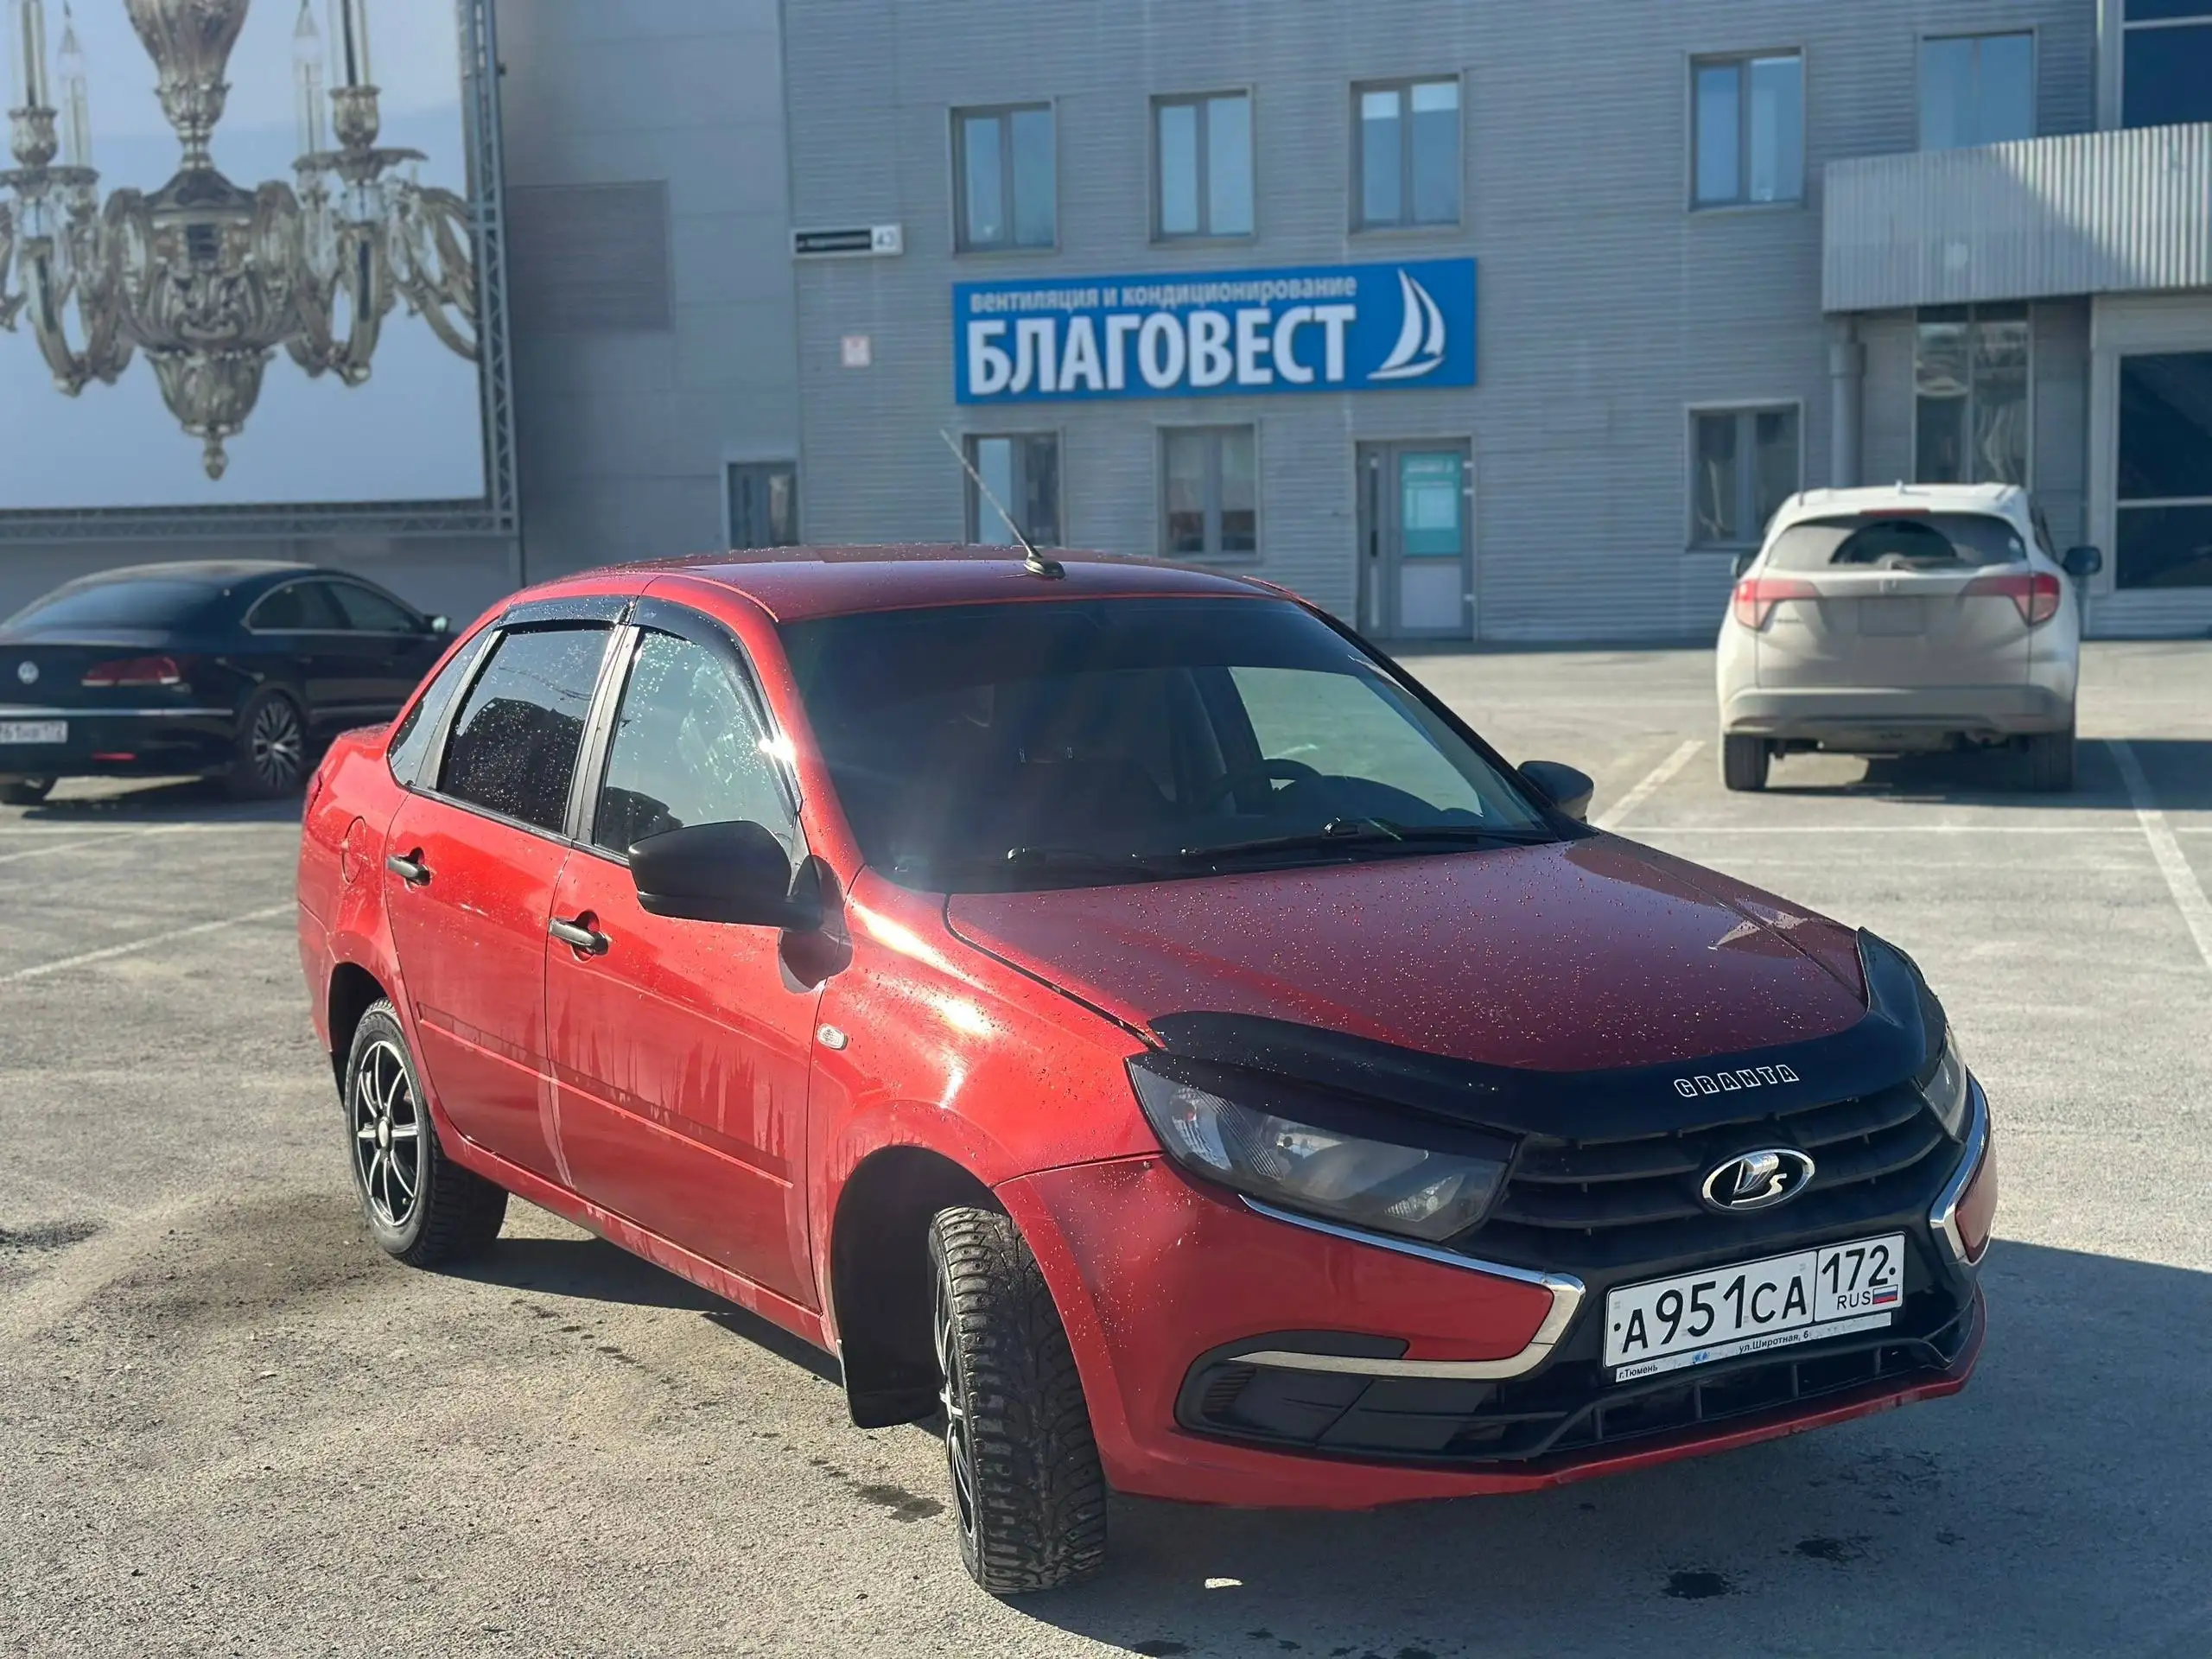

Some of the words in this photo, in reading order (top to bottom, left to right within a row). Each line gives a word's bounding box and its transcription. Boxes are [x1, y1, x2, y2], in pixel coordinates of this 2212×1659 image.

[969, 288, 1100, 314] вентиляция
[1103, 288, 1117, 308] и
[1122, 276, 1358, 311] кондиционирование
[967, 304, 1357, 395] БЛАГОВЕСТ
[1673, 1064, 1800, 1098] GRANTA
[1621, 1274, 1808, 1354] А951СА
[1821, 1244, 1890, 1294] 172
[1836, 1290, 1872, 1311] RUS
[1618, 1363, 1658, 1380] г.Тюмень
